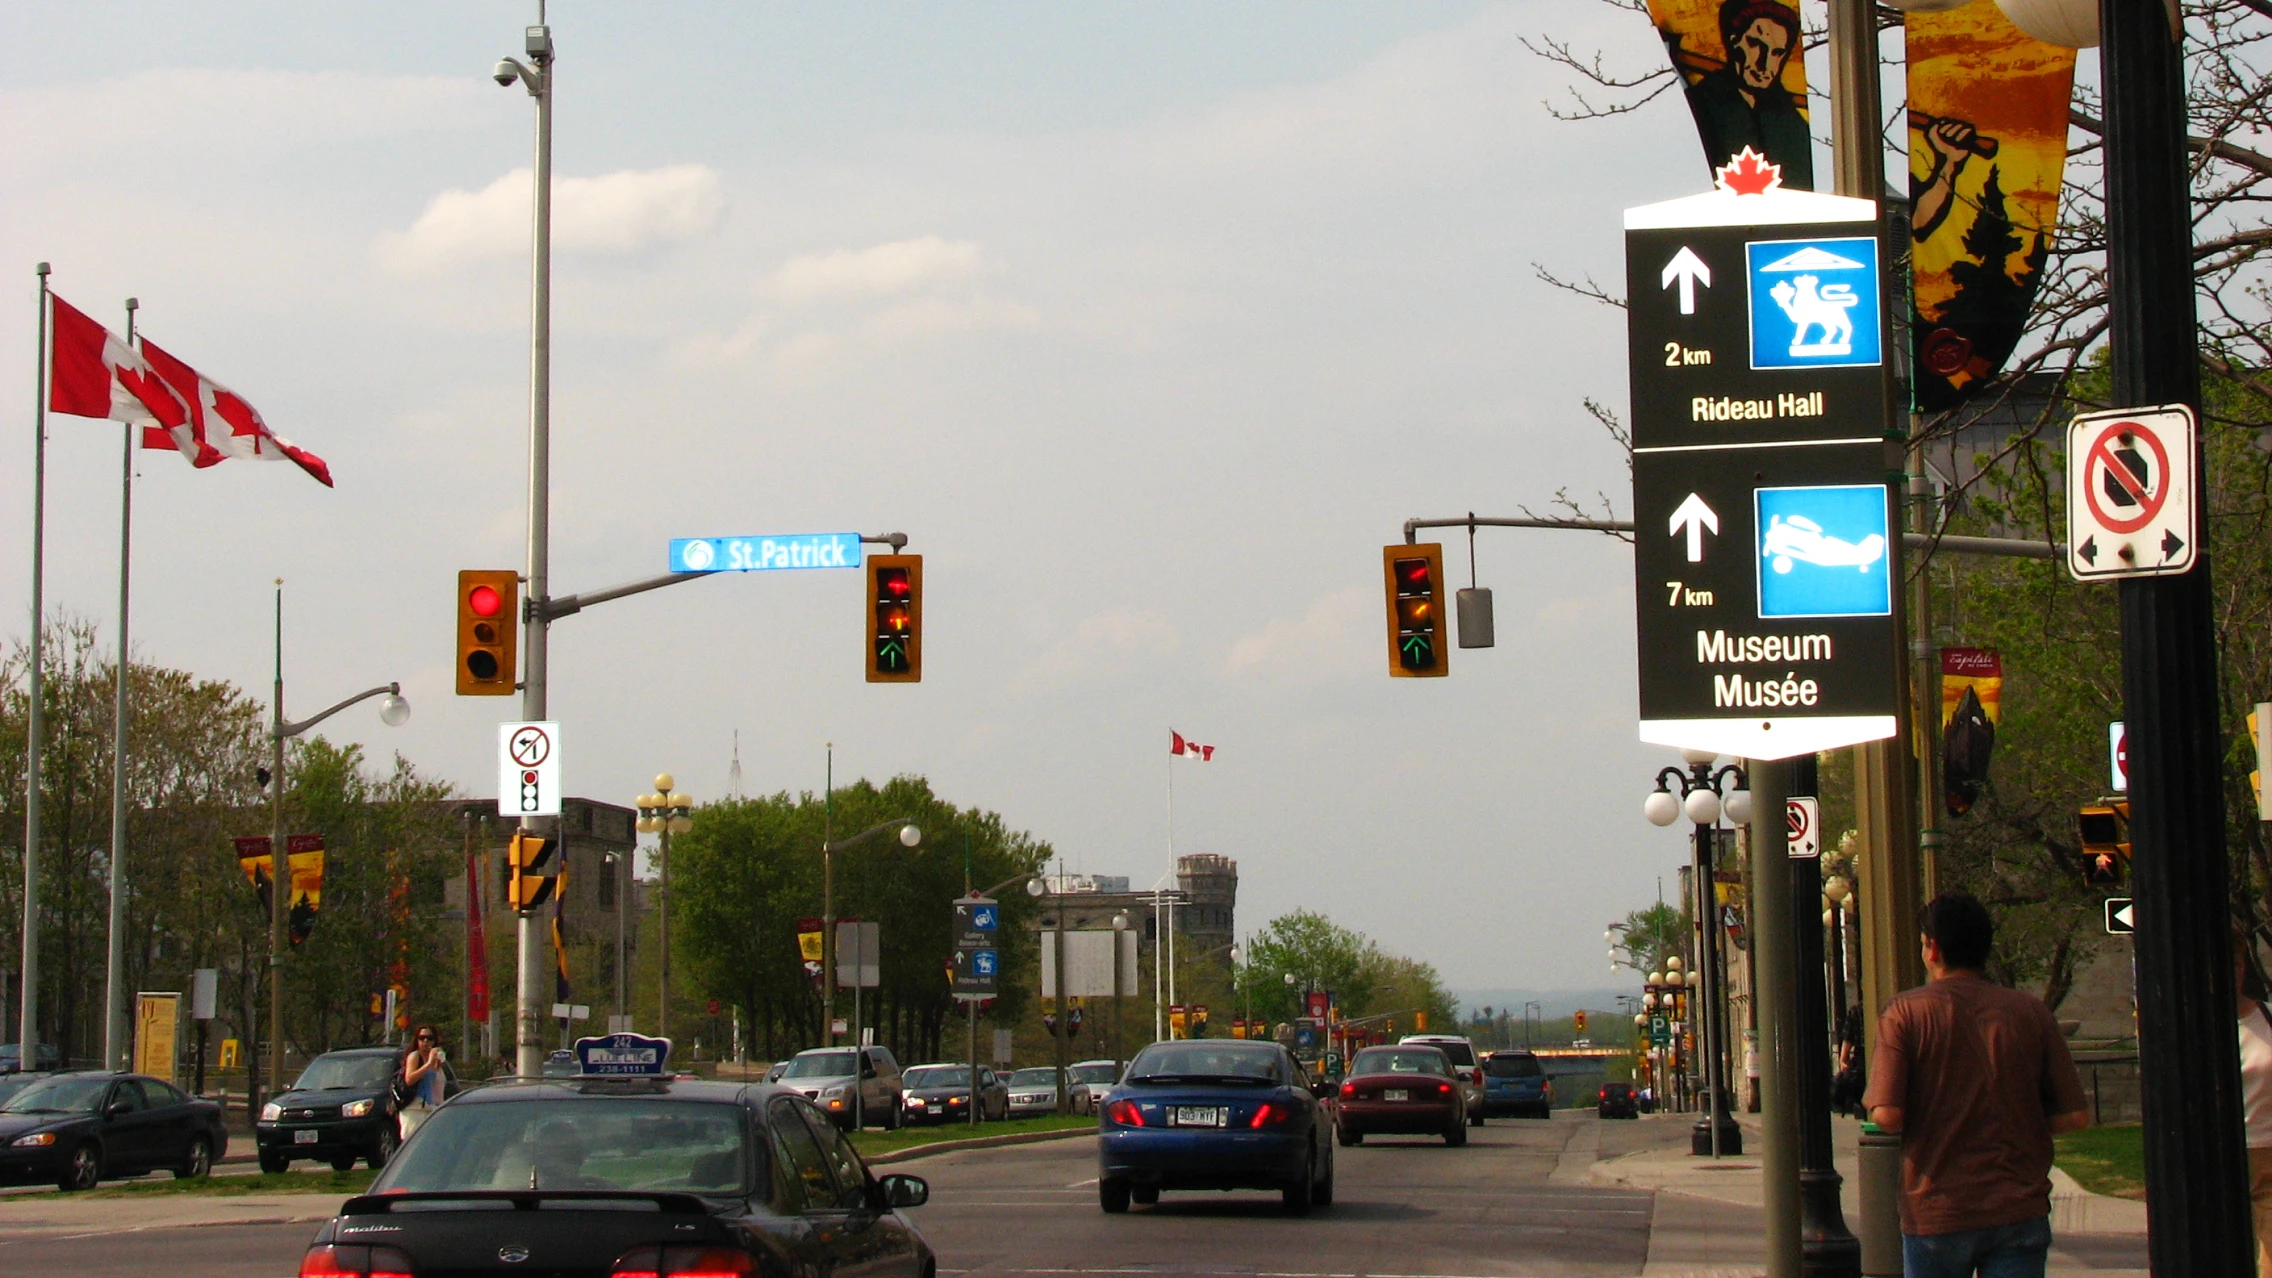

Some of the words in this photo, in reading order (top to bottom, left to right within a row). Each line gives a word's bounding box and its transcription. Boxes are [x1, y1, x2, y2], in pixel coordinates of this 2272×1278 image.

[1664, 341, 1681, 367] 2
[1683, 347, 1711, 366] km
[1691, 396, 1773, 422] Rideau
[1778, 391, 1823, 418] Hall
[1666, 581, 1683, 607] 7
[1685, 587, 1714, 606] km
[1697, 629, 1832, 663] Museum
[1714, 671, 1818, 708] Musée
[1652, 1017, 1665, 1034] P
[613, 1036, 632, 1048] 242
[599, 1065, 645, 1073] 238-1111
